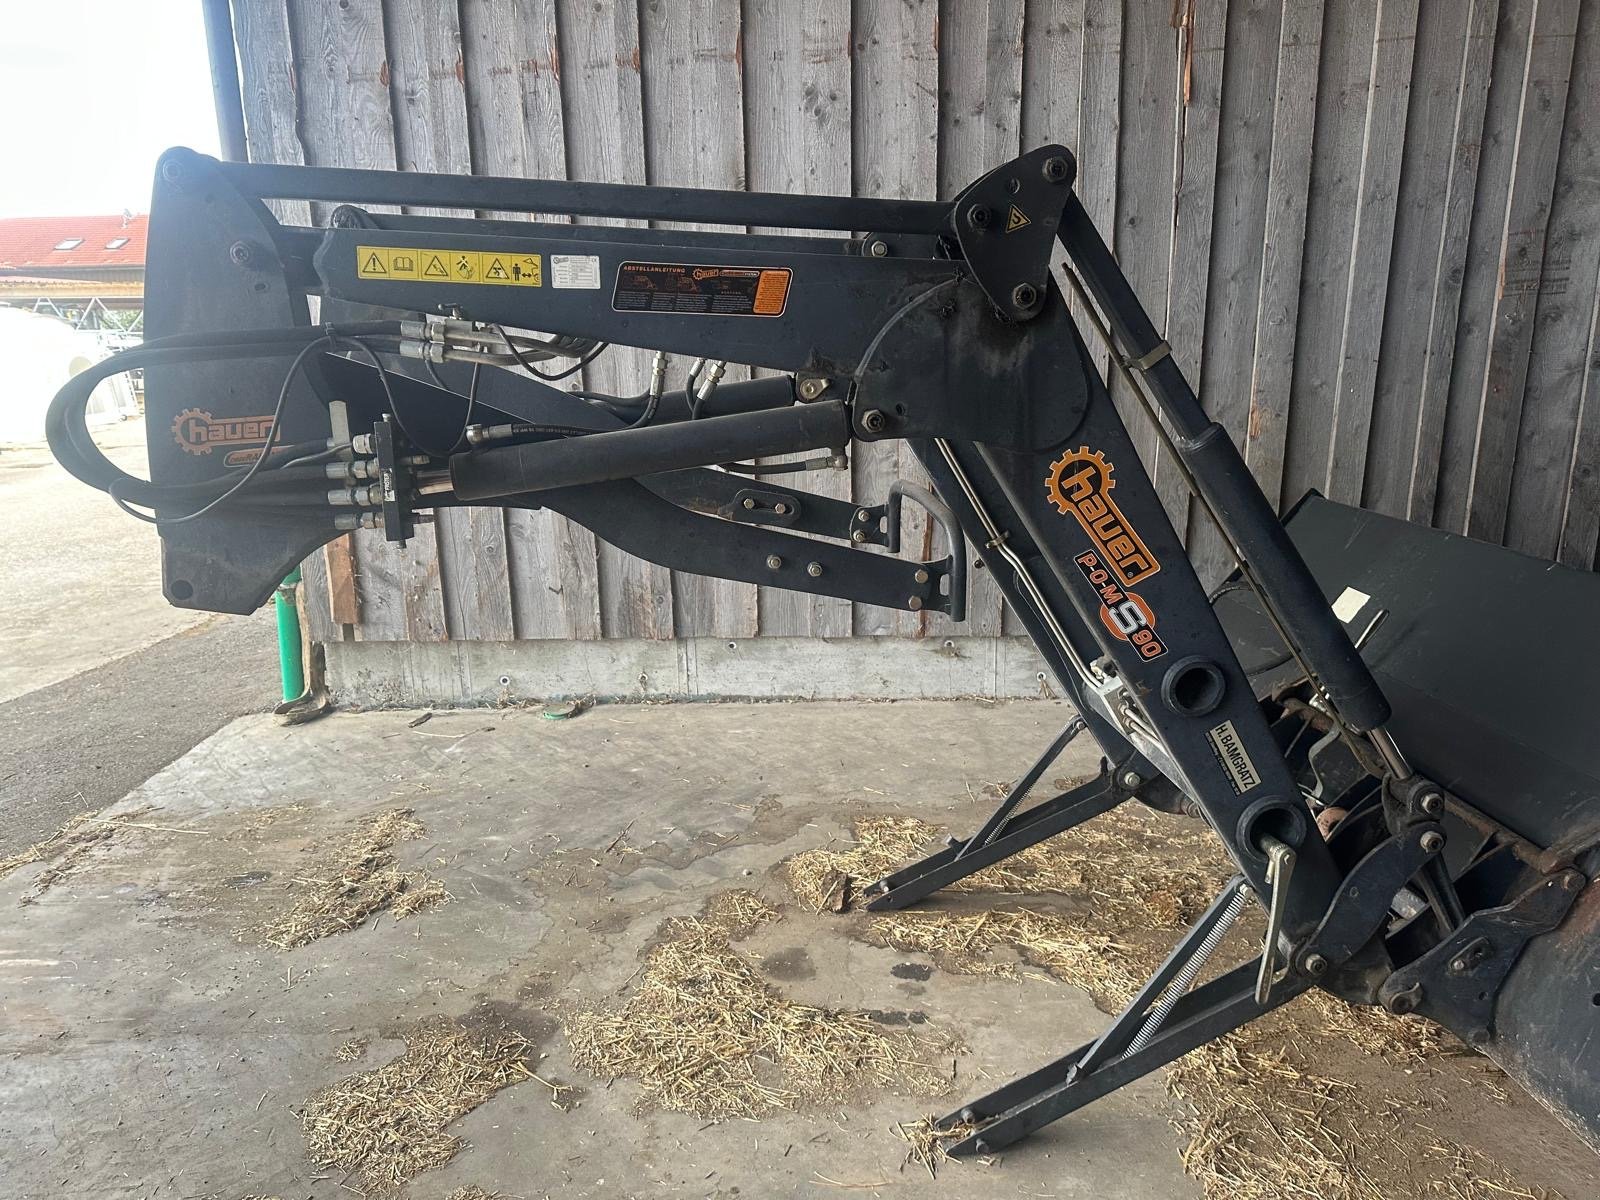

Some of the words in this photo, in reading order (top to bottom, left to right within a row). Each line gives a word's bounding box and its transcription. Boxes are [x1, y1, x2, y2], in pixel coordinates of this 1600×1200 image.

[623, 265, 686, 273] ABSTELLANLEITUNG
[189, 419, 276, 442] hauer
[1061, 466, 1149, 571] hauer
